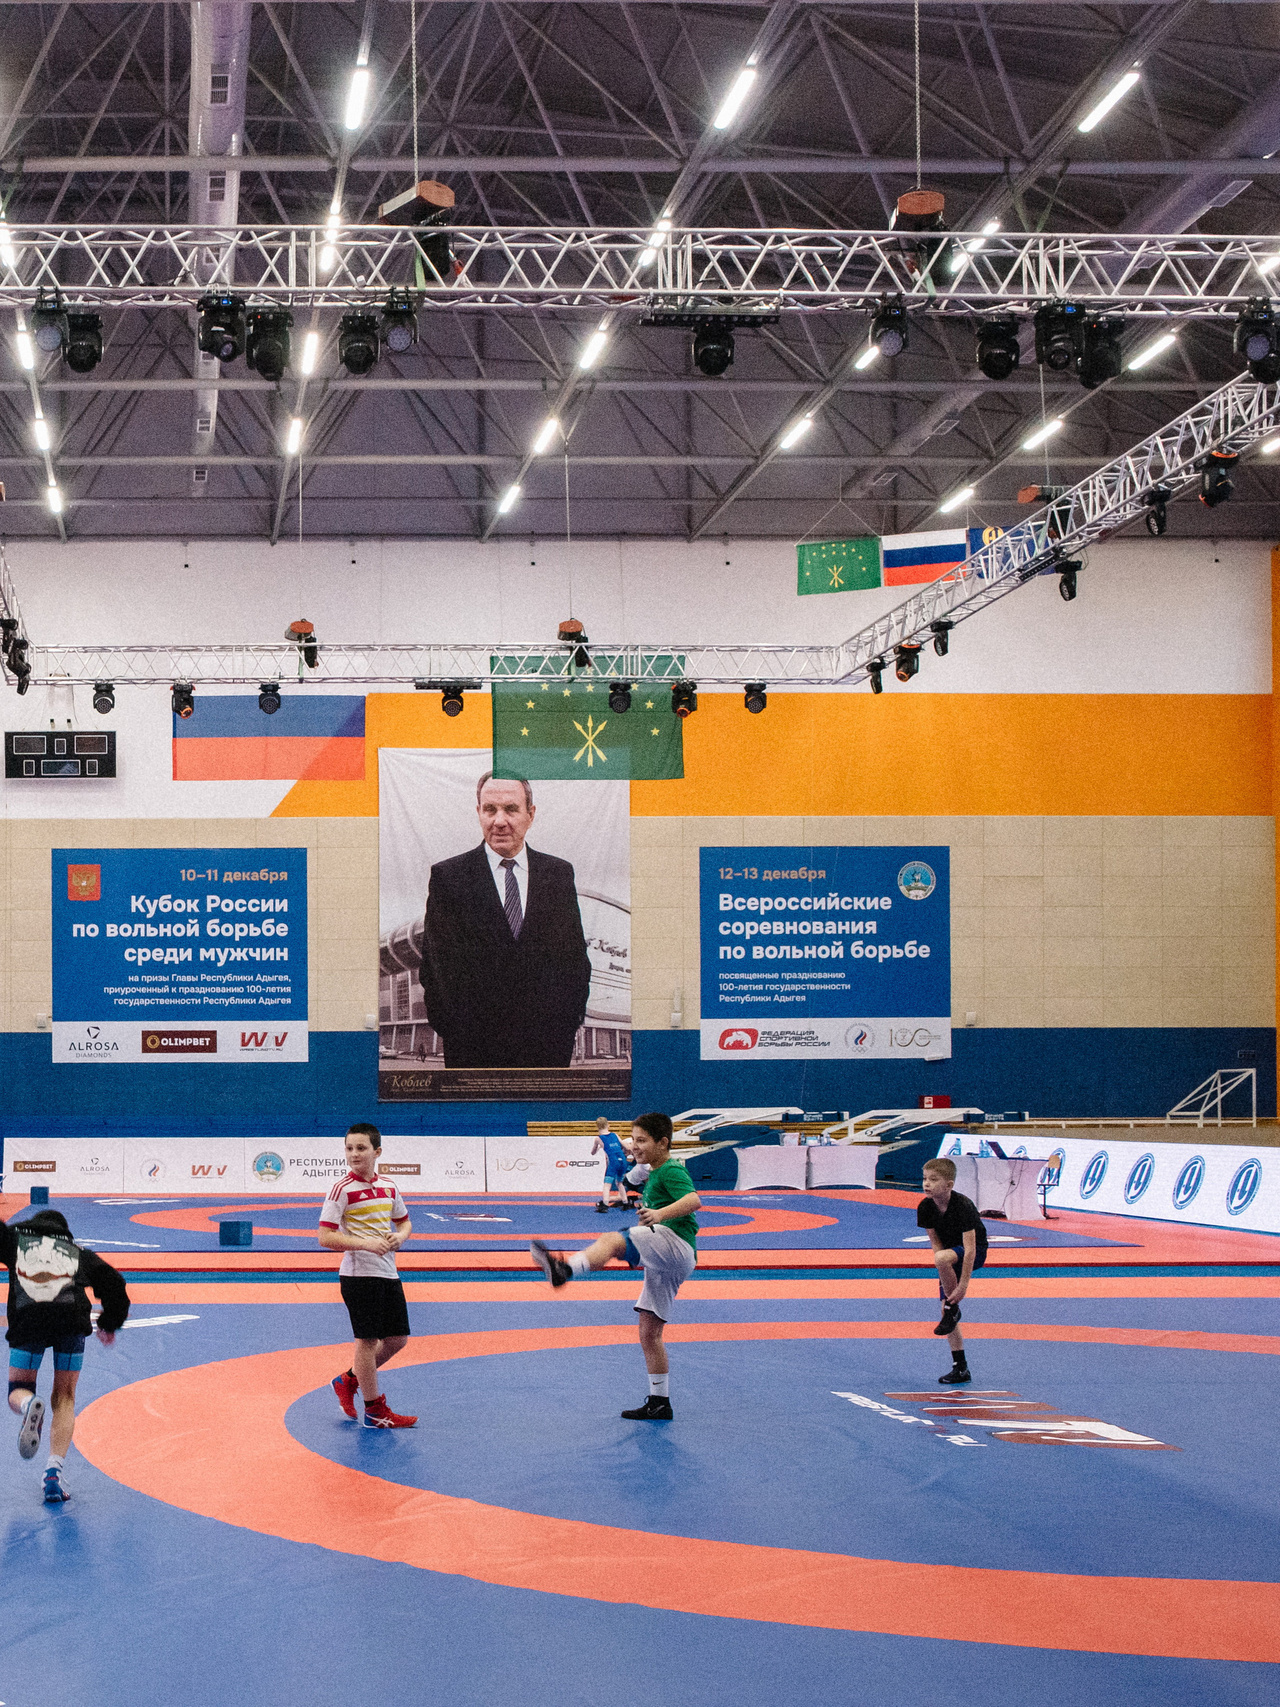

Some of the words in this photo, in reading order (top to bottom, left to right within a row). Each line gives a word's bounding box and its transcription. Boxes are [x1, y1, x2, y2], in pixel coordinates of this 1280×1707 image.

[222, 868, 288, 884] декабря
[762, 867, 826, 882] декабря
[130, 894, 200, 918] Кубок
[206, 895, 289, 913] России
[719, 893, 892, 915] Всероссийские
[72, 923, 99, 937] по
[106, 919, 200, 937] вольной
[206, 918, 289, 941] борьбе
[718, 920, 877, 939] соревнования
[719, 945, 746, 960] по
[752, 941, 844, 959] вольной
[850, 940, 931, 963] борьбе
[124, 948, 192, 966] среди
[200, 948, 289, 967] мужчин
[141, 975, 170, 984] призы
[171, 974, 199, 982] Главы
[200, 974, 254, 984] Республики
[255, 974, 291, 983] Адыгея,
[719, 972, 779, 980] посвященные
[781, 972, 846, 981] празднованию
[103, 985, 170, 995] приуроченный
[178, 986, 245, 996] празднованию
[246, 985, 291, 993] 100-летия
[719, 983, 763, 991] 100-летия
[765, 983, 851, 993] государственности
[114, 997, 200, 1007] государственности
[203, 996, 257, 1007] Республики
[258, 996, 291, 1006] Адыгея
[719, 994, 771, 1004] Республики
[773, 994, 806, 1003] Адыгея
[68, 1042, 119, 1051] ALROSA
[161, 1037, 211, 1046] OLIMPBET
[289, 1158, 349, 1166] РЕСПУБЛИ
[302, 1169, 347, 1178] АДЫГЕЯ
